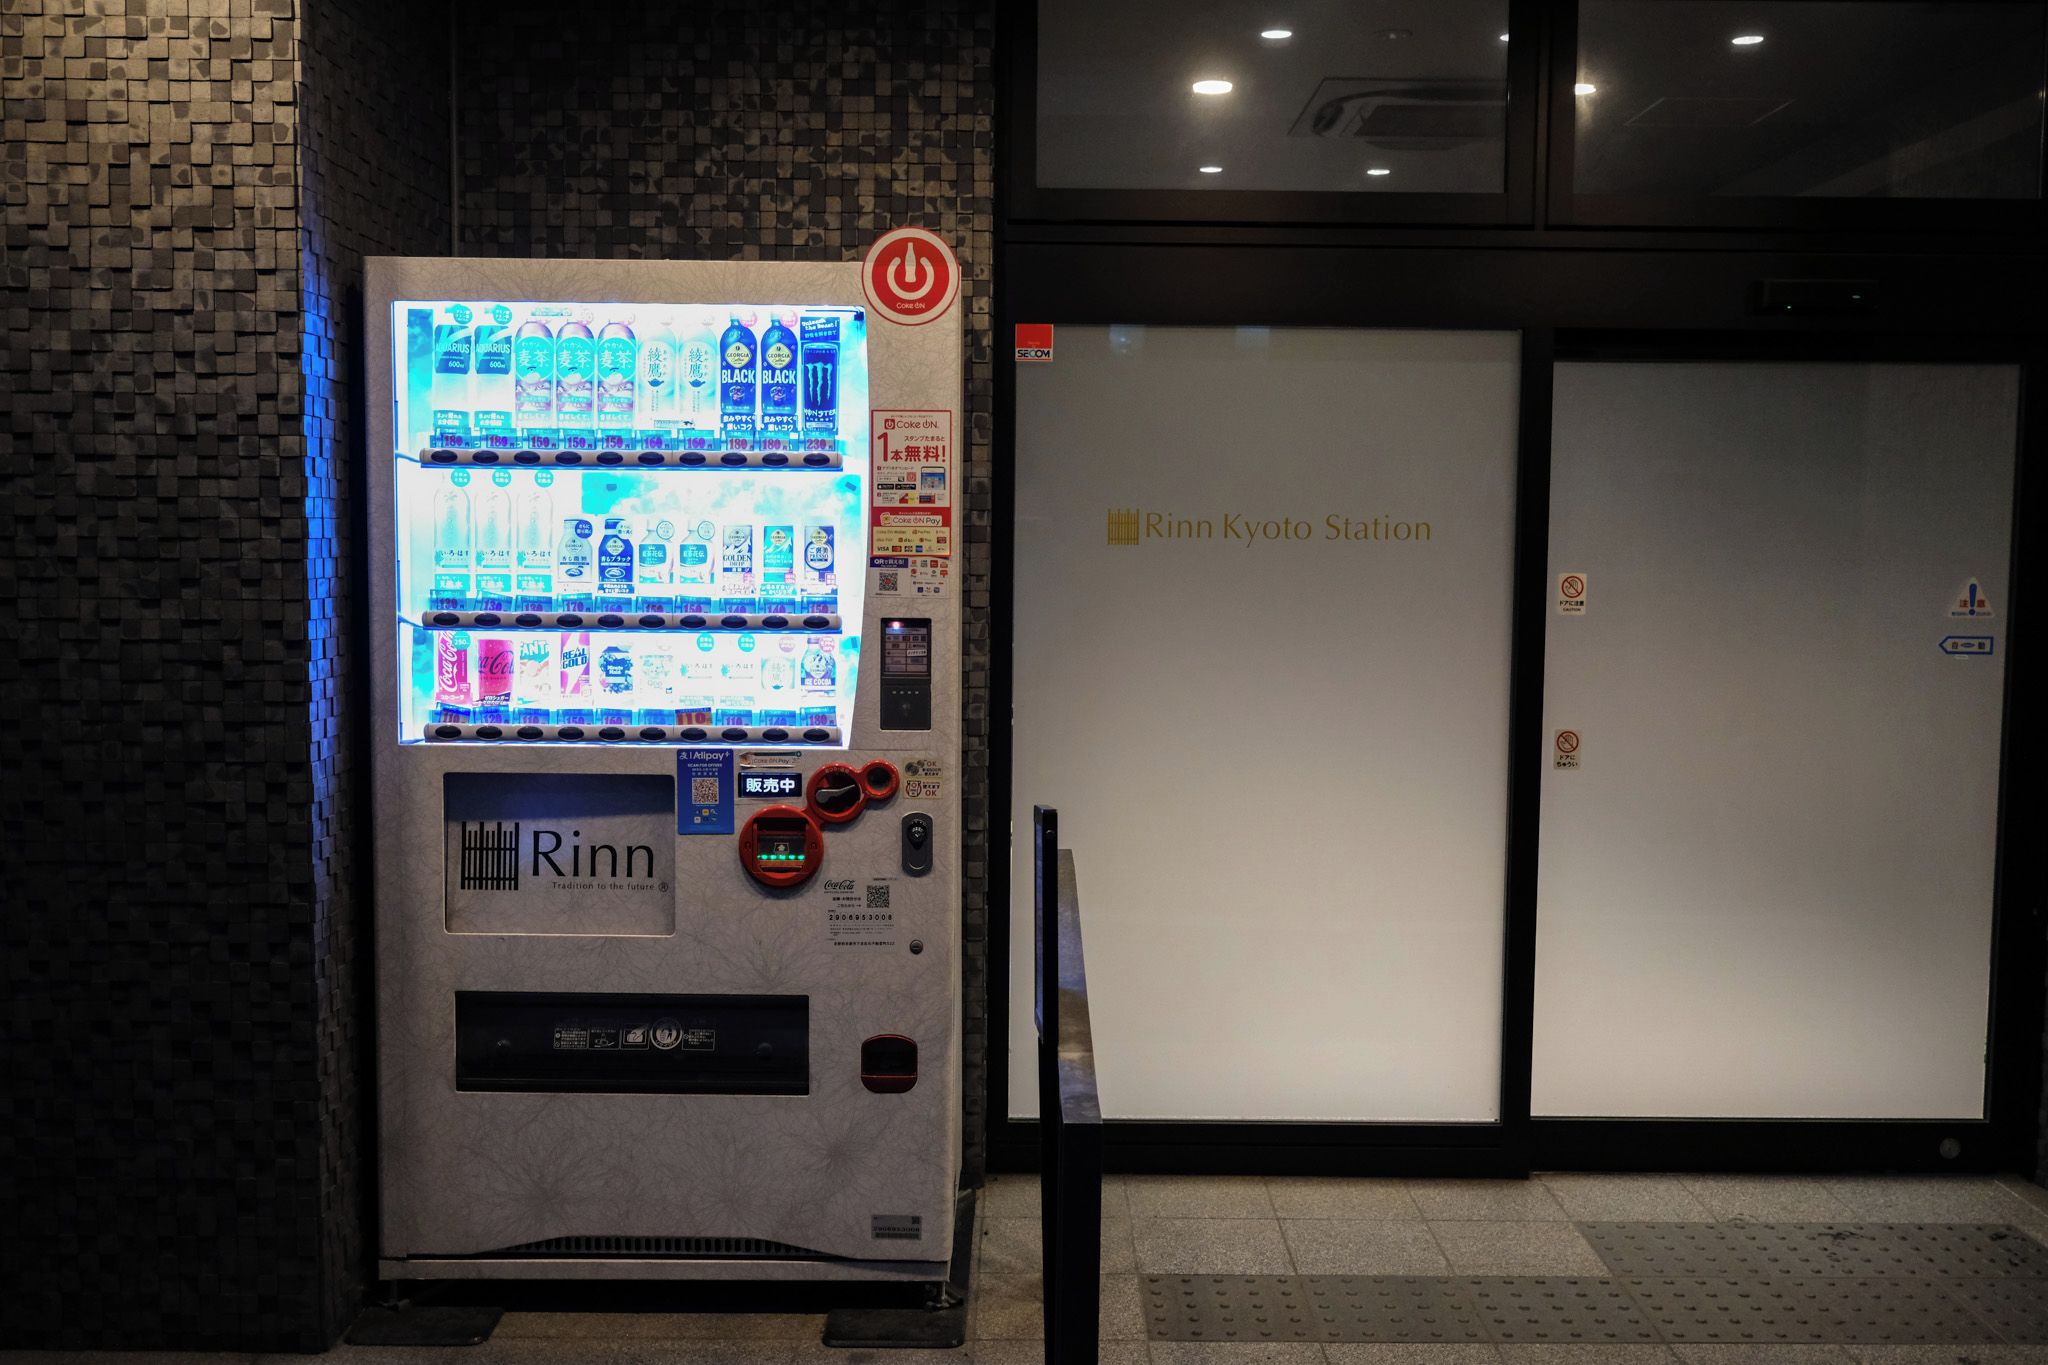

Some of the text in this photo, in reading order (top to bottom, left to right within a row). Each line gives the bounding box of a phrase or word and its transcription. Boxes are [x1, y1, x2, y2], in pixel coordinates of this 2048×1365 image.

[518, 350, 550, 368] 麦茶
[558, 350, 590, 368] 麦茶
[600, 350, 632, 368] 麦茶
[1018, 350, 1050, 358] SECOM
[722, 369, 755, 384] BLACK
[763, 370, 796, 384] BLACK
[897, 419, 938, 428] Coke ON
[1146, 512, 1432, 548] Rinn Kyoto Station
[562, 648, 586, 660] REAL
[562, 656, 588, 670] GOLD
[746, 778, 795, 793] 販売中
[533, 830, 654, 878] Rinn
[552, 882, 593, 890] Tradition
[610, 882, 624, 890] the
[627, 883, 654, 891] future
